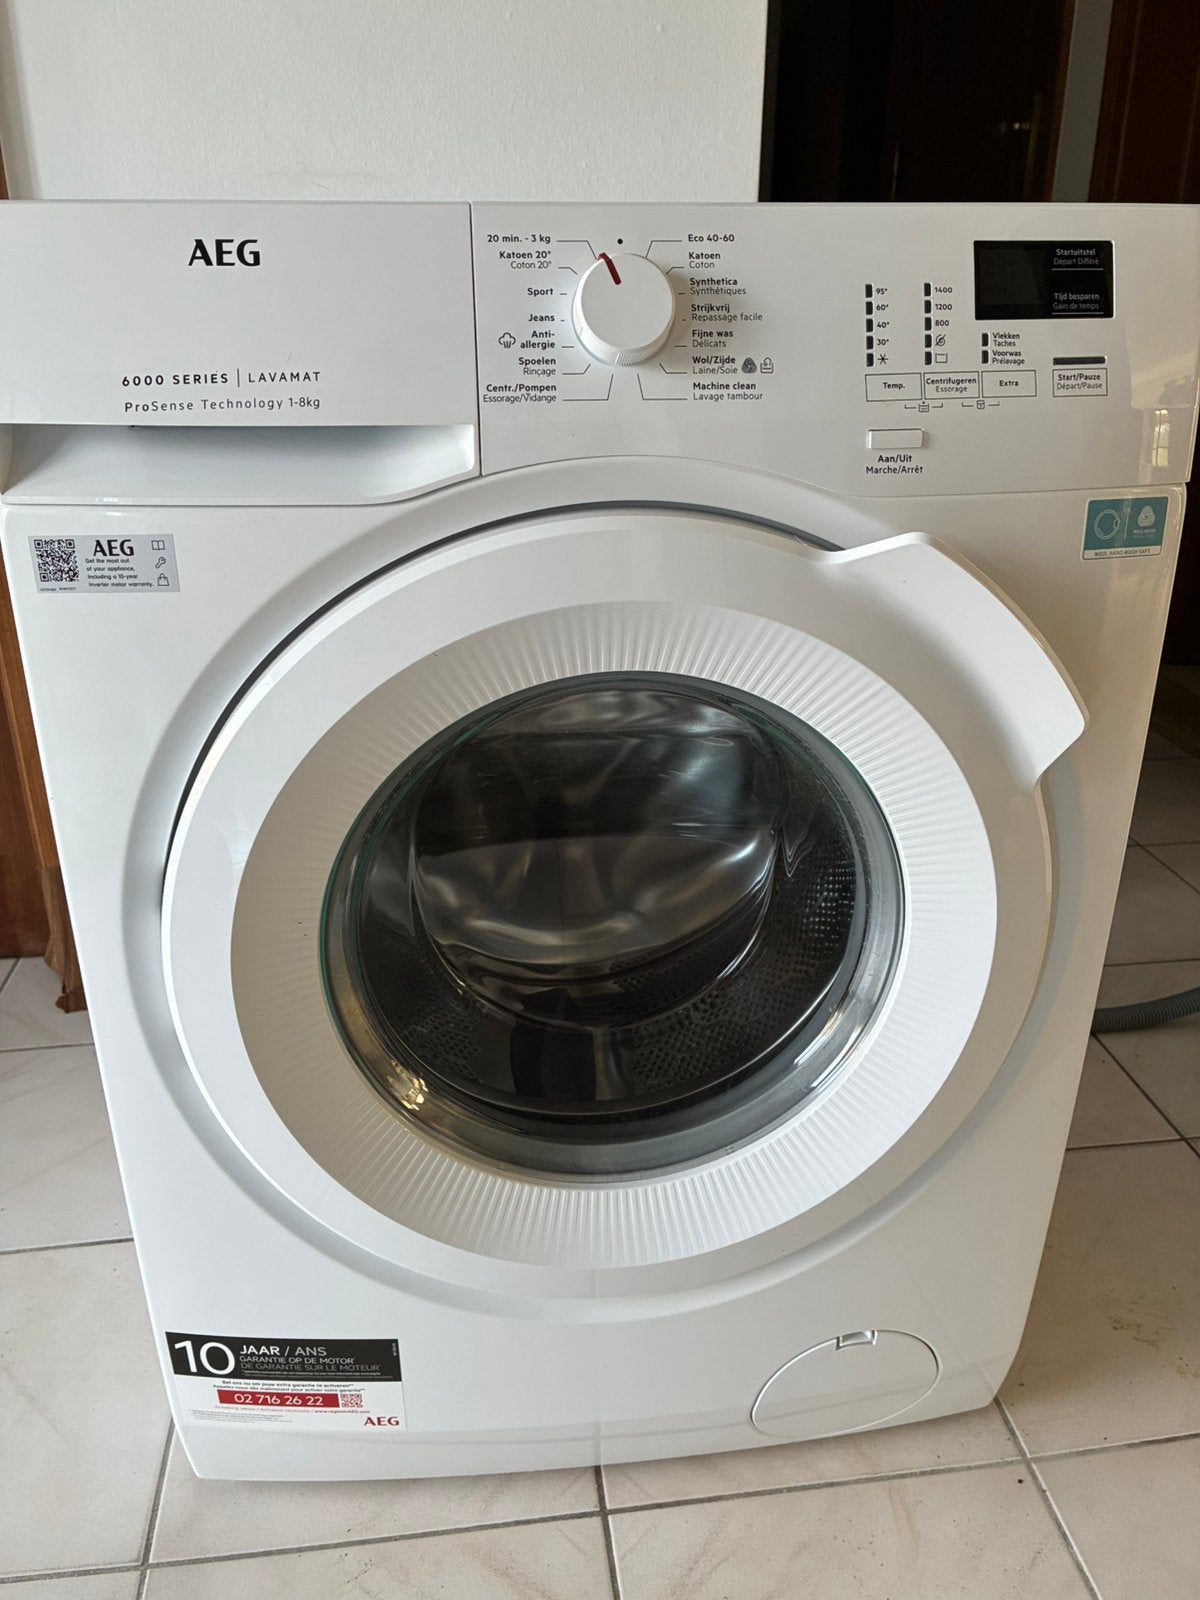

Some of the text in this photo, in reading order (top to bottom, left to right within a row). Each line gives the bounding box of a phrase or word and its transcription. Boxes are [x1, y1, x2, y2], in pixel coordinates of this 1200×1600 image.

[487, 234, 500, 243] 20
[503, 234, 522, 243] min.
[531, 234, 537, 243] 3
[539, 234, 551, 245] kg
[688, 234, 735, 242] Eco 40-60
[188, 239, 260, 266] AEG
[499, 250, 552, 259] Katoen 20°
[688, 252, 721, 260] Katoen
[1056, 248, 1096, 256] Startuitstel
[537, 260, 552, 268] 20°
[689, 261, 715, 269] Coton
[690, 278, 738, 288] Synthetica
[527, 287, 554, 298] Sport
[690, 286, 746, 296] Synthétiques
[1053, 292, 1099, 301] Tijd besparen
[691, 303, 730, 314] Strijkvrij
[1053, 302, 1099, 310] Gain de temps
[528, 313, 555, 322] Jeans
[691, 312, 763, 323] Repassage facile
[531, 330, 555, 338] Anti-
[692, 329, 714, 340] Fijne
[520, 340, 556, 350] allergie
[692, 338, 726, 348] Délicats
[518, 357, 556, 368] Spoelen
[692, 356, 736, 366] Wol/Zijde
[992, 357, 1025, 366] Prélavage
[523, 367, 556, 378] Rinçage
[692, 366, 738, 375] Laine/Soie
[122, 372, 321, 386] 6000 SERIES LAVAMAT
[926, 377, 977, 386] Centrifugeren
[1058, 373, 1101, 382] Start/Pauze
[693, 382, 756, 390] Machine clean
[883, 382, 906, 390] Temp.
[999, 379, 1019, 387] Extra
[1056, 381, 1102, 391] Départ/Pause
[486, 383, 557, 394] Centr./Pompen
[936, 385, 968, 393] Essorage
[483, 394, 556, 404] Essorage/Vidange
[693, 392, 763, 402] Lavage tambour
[125, 397, 320, 412] ProSense Technology 1-8kg
[878, 454, 912, 464] Aan/Uit
[866, 464, 923, 474] Marche/Arrêt
[93, 539, 135, 556] AEG
[240, 1345, 280, 1355] JAAR
[295, 1347, 327, 1356] ANS
[174, 1340, 236, 1375] 10
[239, 1355, 286, 1363] GARANTIE
[234, 1393, 324, 1406] 02 716 26 22
[364, 1417, 400, 1426] AEG
